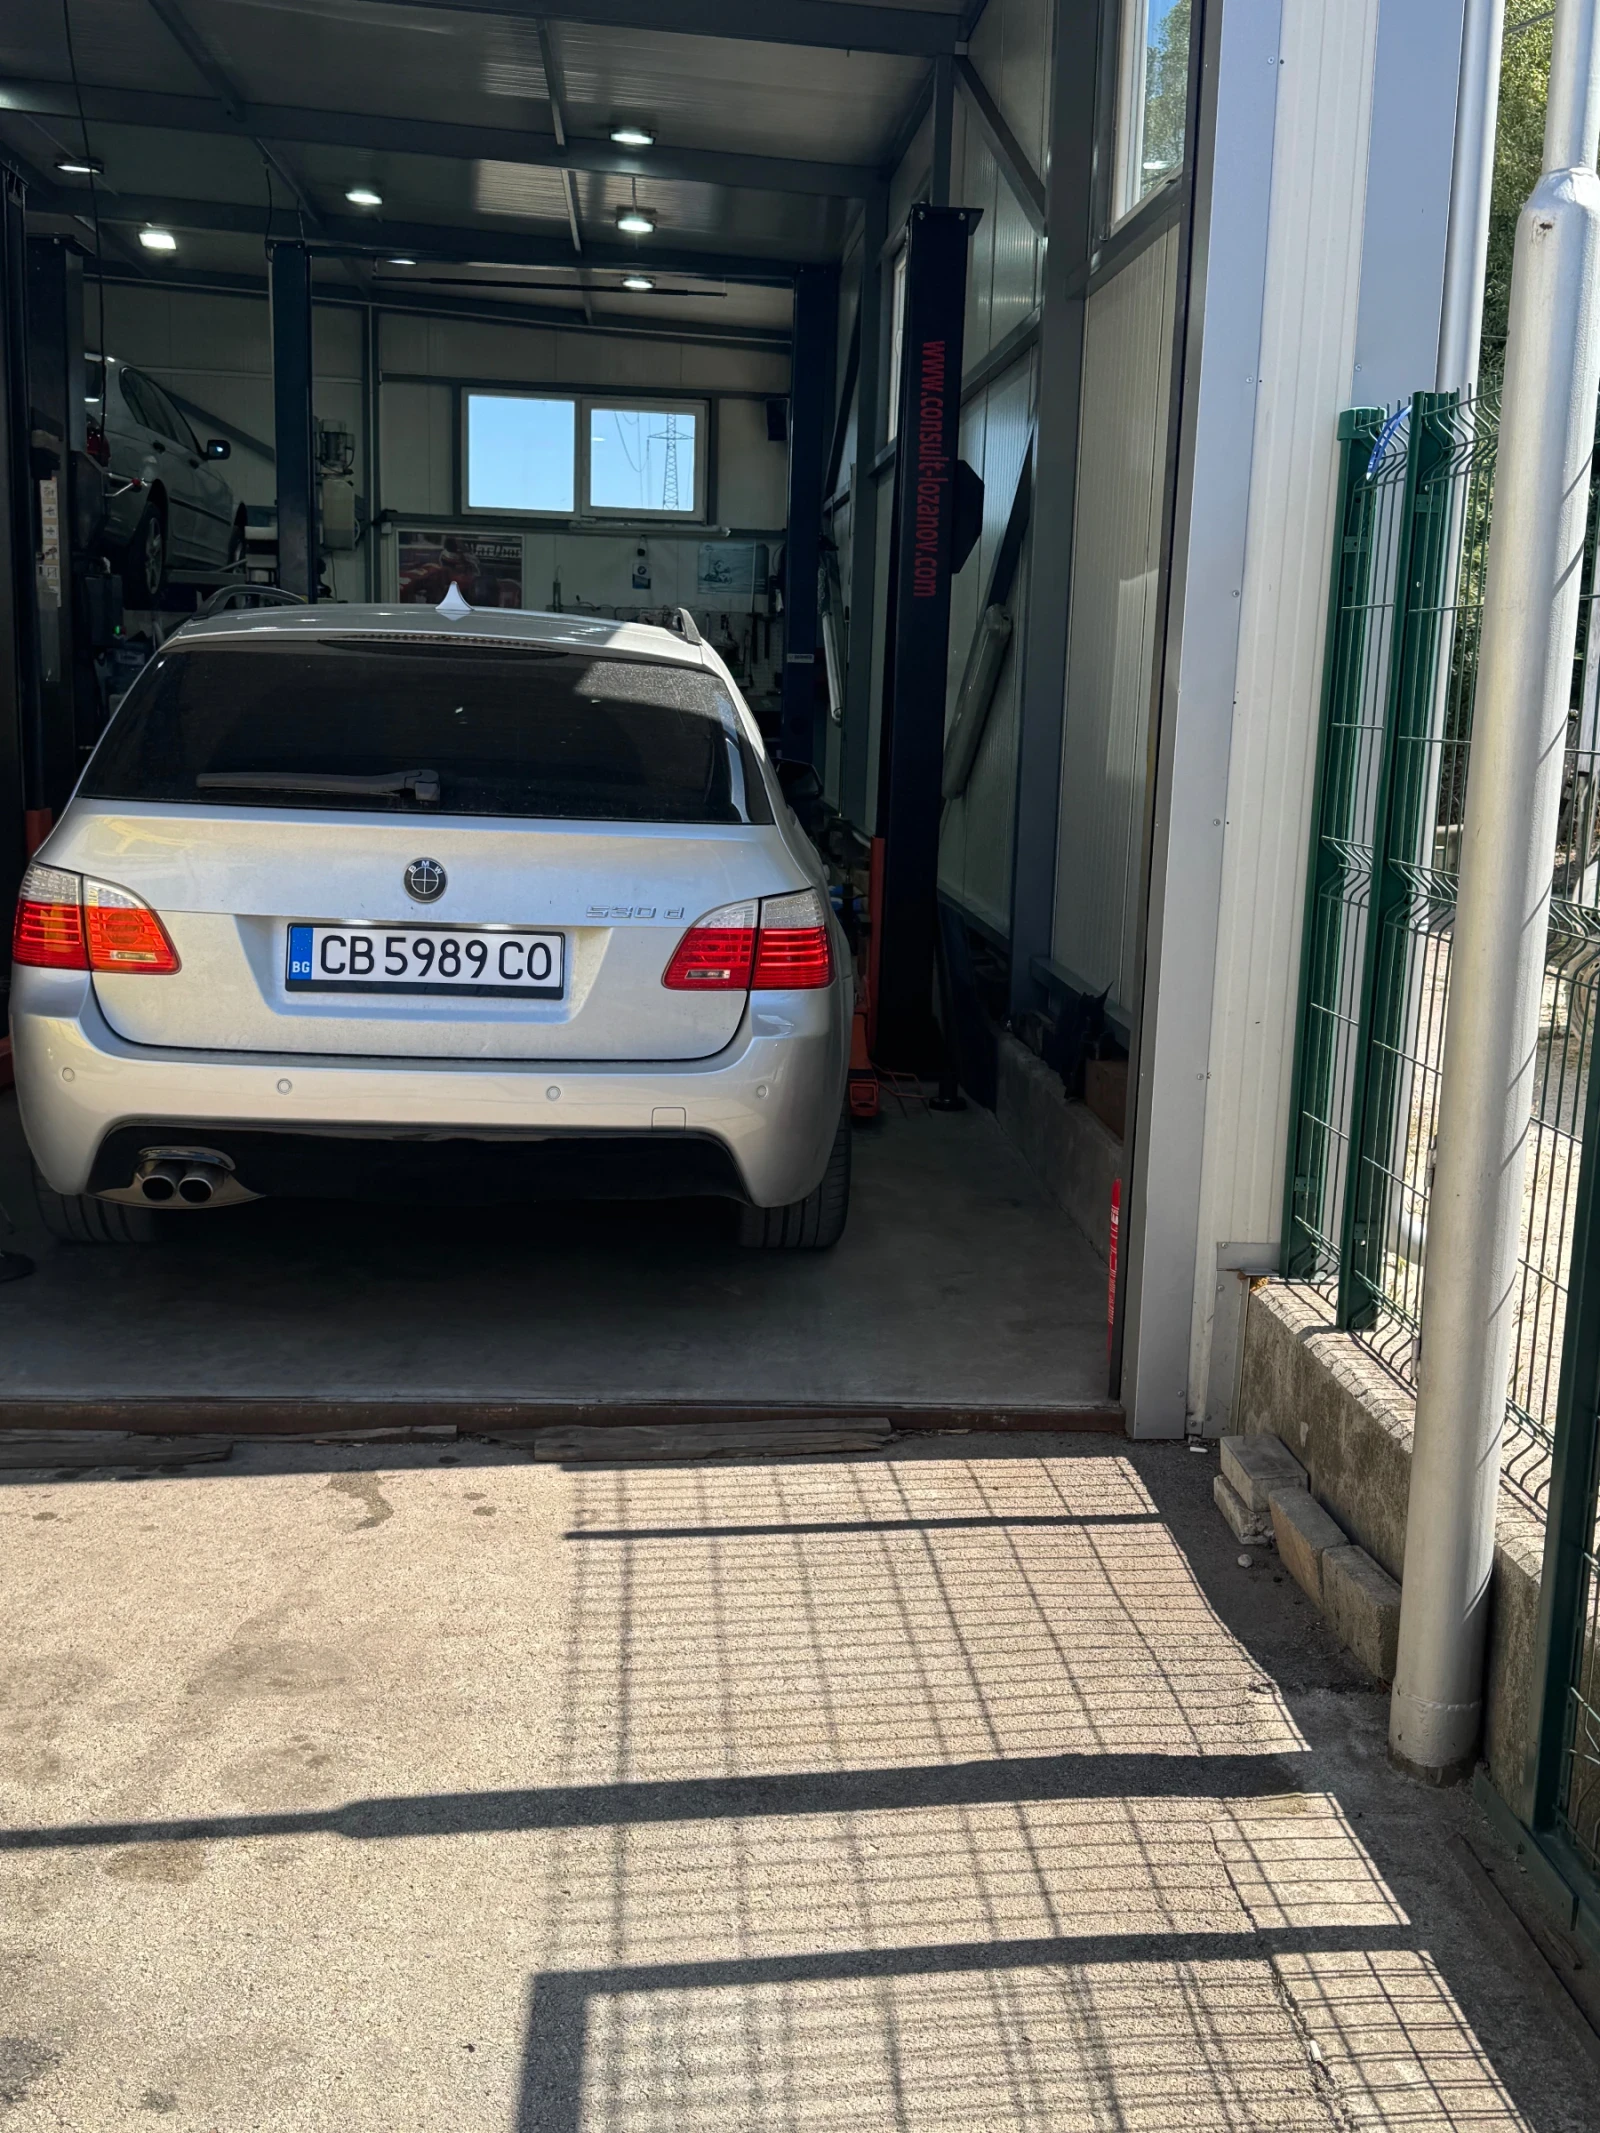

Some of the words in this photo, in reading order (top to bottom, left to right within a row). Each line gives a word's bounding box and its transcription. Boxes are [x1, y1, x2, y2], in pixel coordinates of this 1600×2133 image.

[914, 341, 949, 597] www.consult-lozanov.com
[408, 860, 442, 874] BMW
[586, 905, 656, 918] 530
[664, 907, 685, 919] d
[320, 935, 375, 976] CB
[385, 937, 489, 978] 5989
[292, 960, 310, 974] BG
